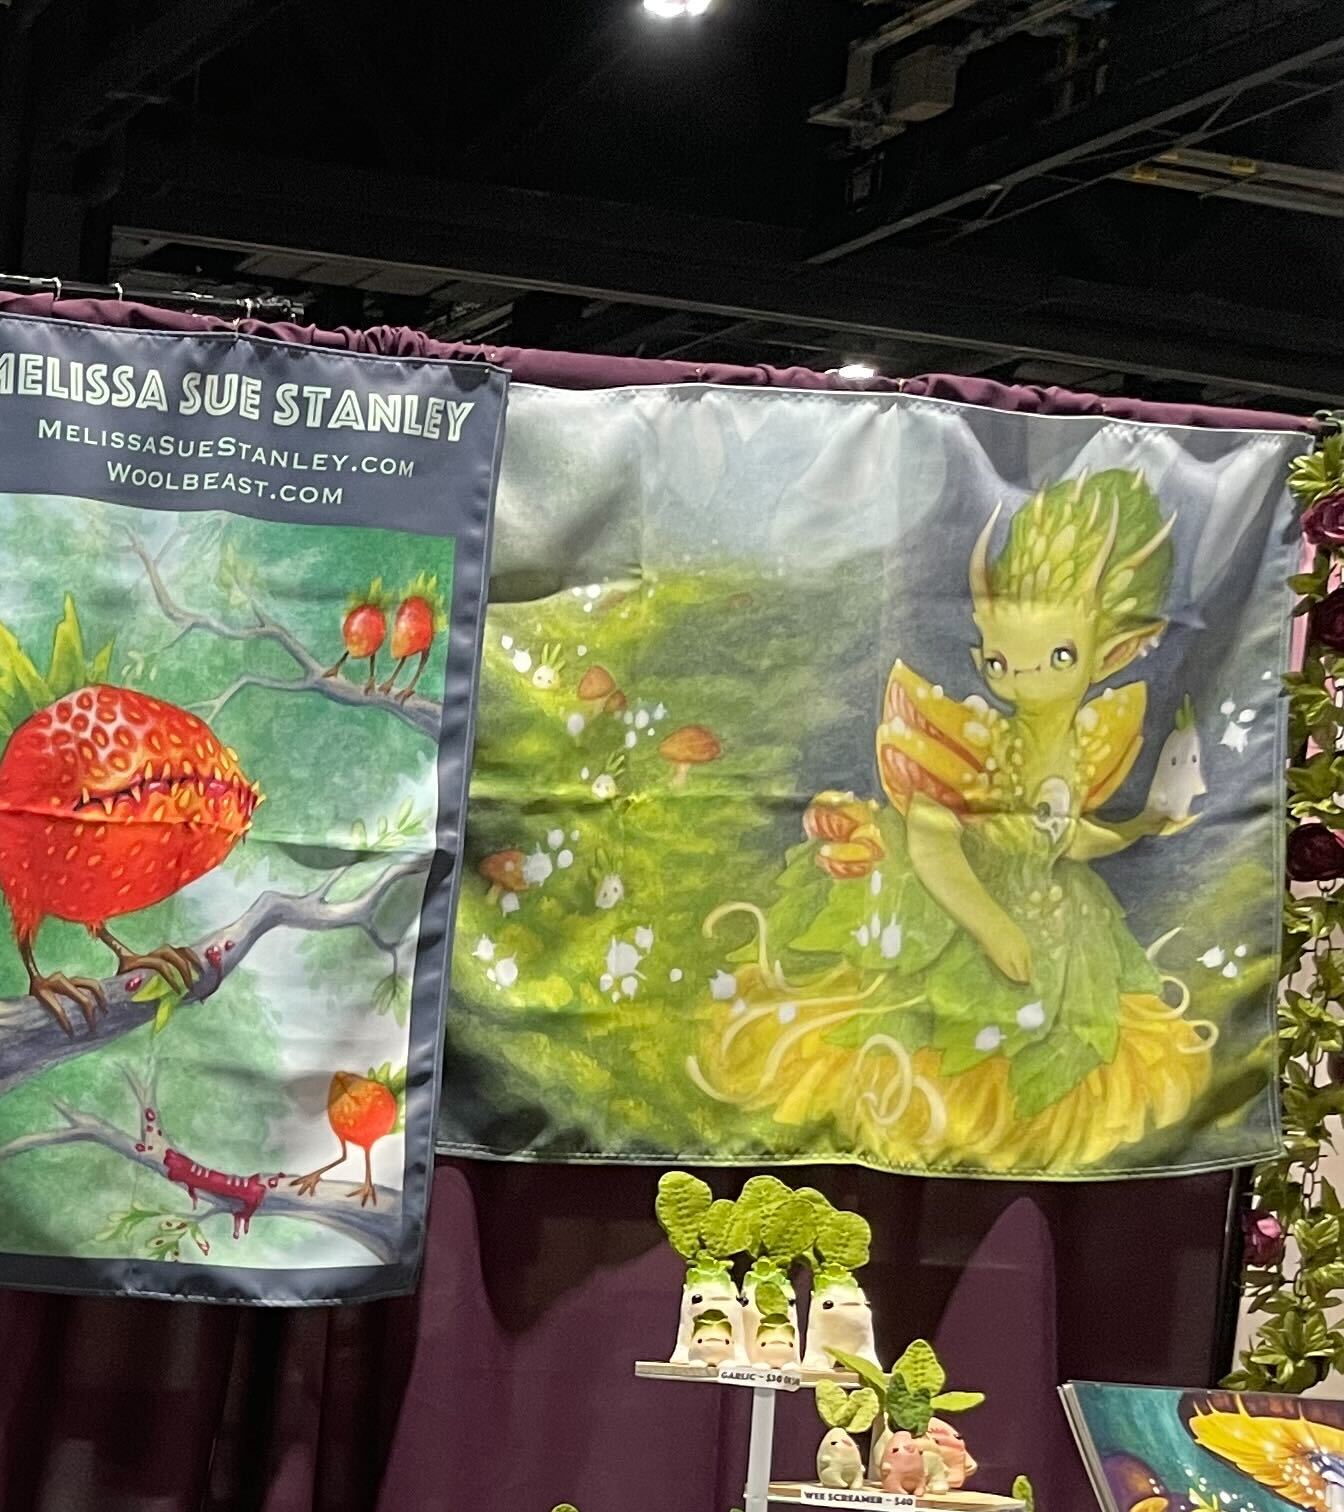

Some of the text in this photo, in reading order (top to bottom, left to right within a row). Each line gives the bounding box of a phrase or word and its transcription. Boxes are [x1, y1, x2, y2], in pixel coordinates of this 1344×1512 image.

[180, 372, 262, 420] SUE
[273, 382, 475, 442] STANLEY
[720, 1371, 756, 1381] GARLIC
[804, 1491, 825, 1500] WEE
[828, 1493, 883, 1504] SCREAMER
